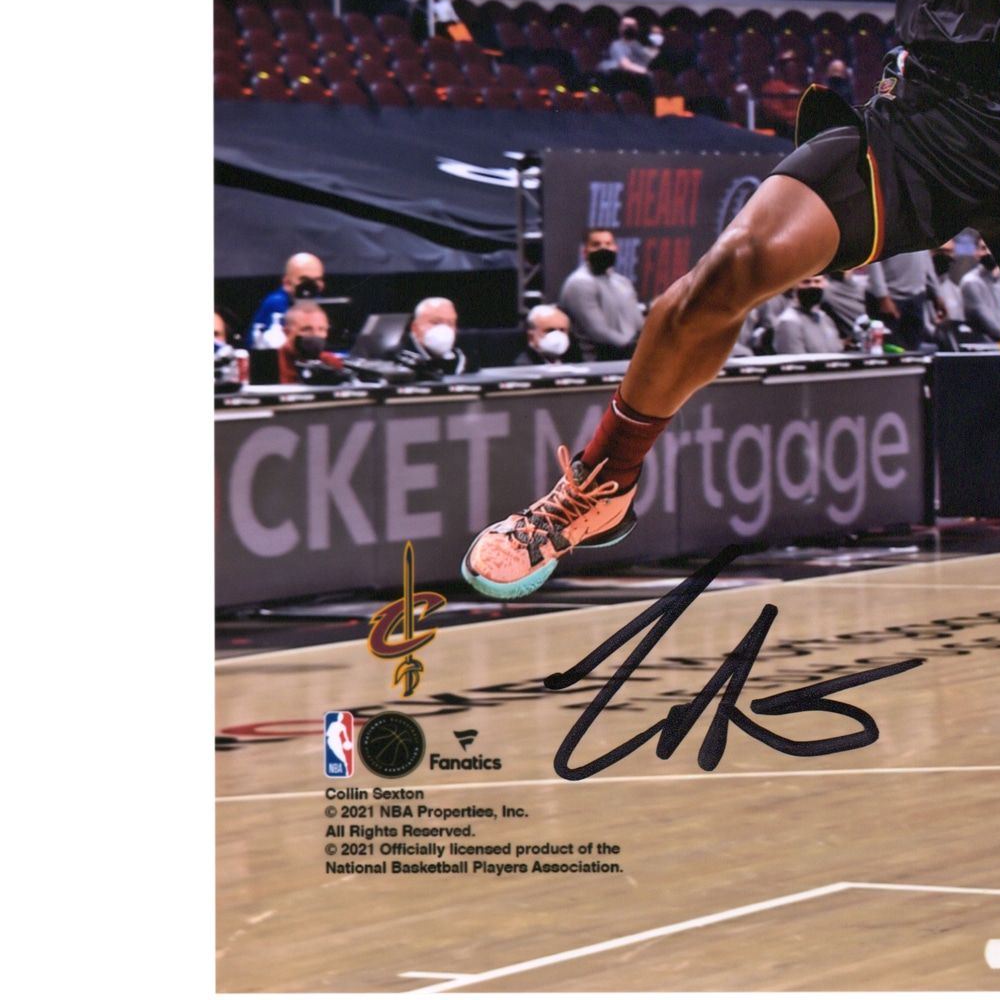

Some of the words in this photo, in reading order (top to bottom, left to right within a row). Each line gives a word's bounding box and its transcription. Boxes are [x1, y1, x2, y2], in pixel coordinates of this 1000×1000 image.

[588, 180, 624, 228] THE
[625, 167, 703, 228] HEART
[227, 411, 510, 558] CKET
